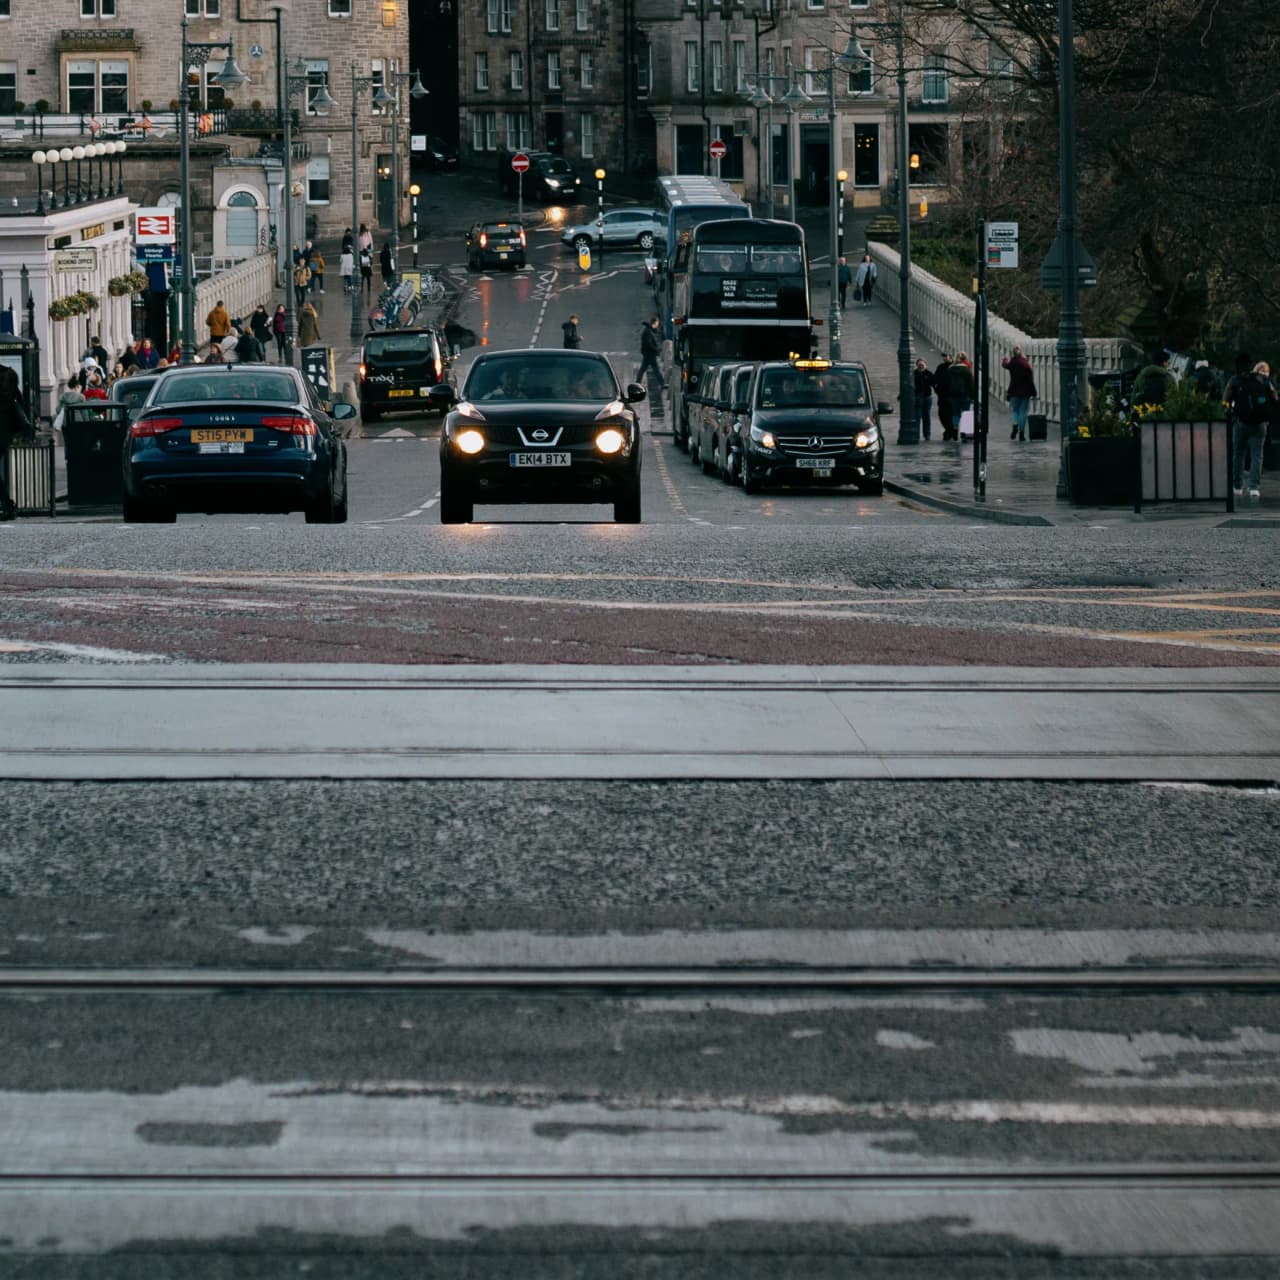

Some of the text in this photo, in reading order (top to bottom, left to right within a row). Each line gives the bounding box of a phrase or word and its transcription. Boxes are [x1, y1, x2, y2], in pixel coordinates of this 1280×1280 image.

[197, 430, 221, 441] ST15
[519, 453, 567, 465] EK14 BTX
